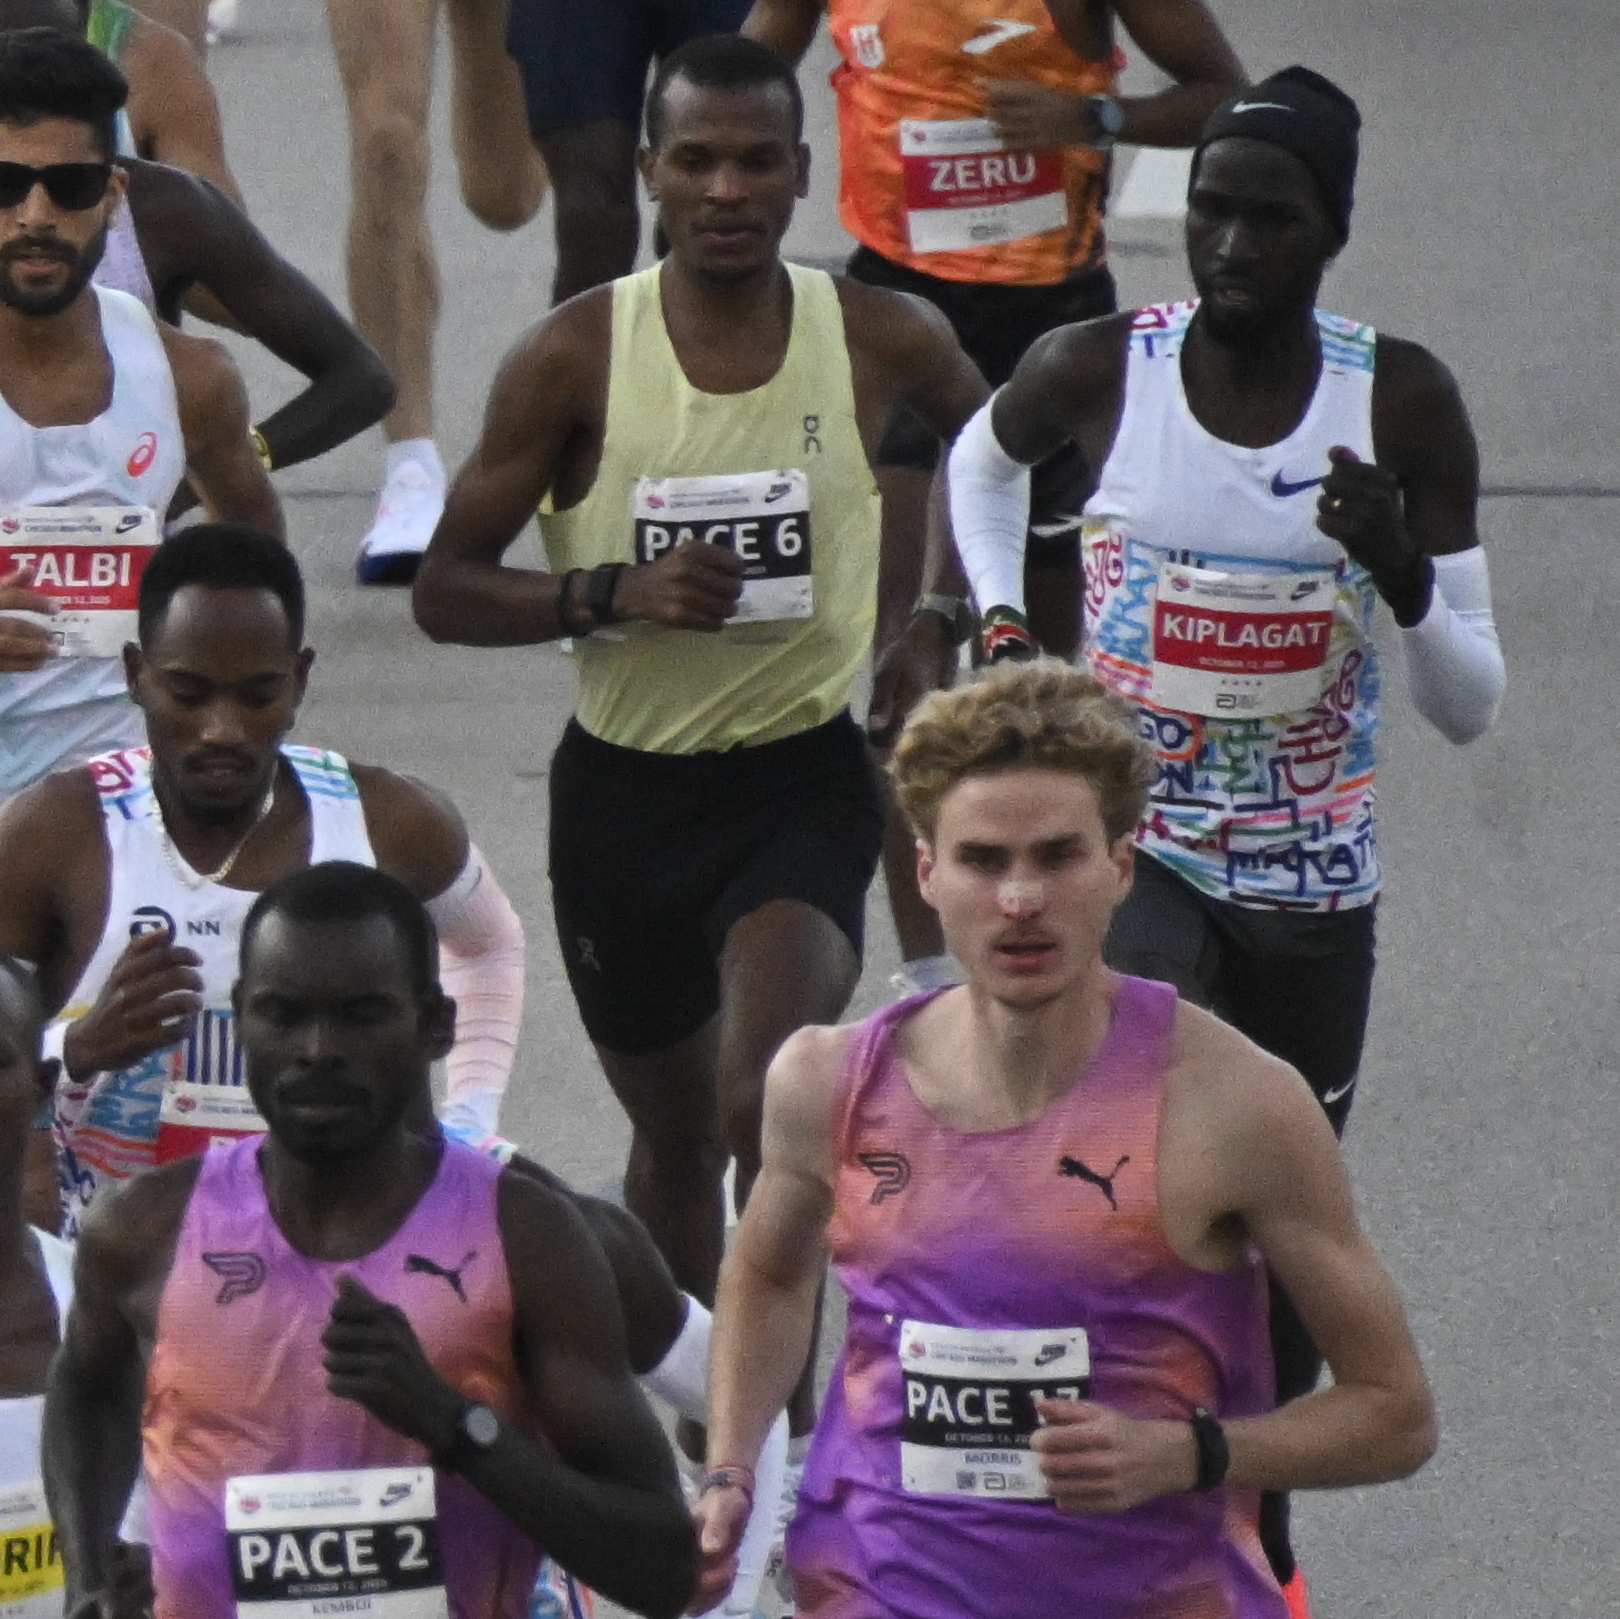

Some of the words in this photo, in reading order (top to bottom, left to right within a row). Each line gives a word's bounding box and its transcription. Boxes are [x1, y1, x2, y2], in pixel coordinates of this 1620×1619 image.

[928, 154, 1036, 192] ZERU
[775, 519, 803, 558] 6
[9, 552, 132, 589] TALBI
[1163, 611, 1328, 648] KIPLAGAT
[186, 920, 221, 936] NN
[907, 1379, 1014, 1426] PACE
[238, 1528, 380, 1582] PACE
[394, 1525, 430, 1569] 2
